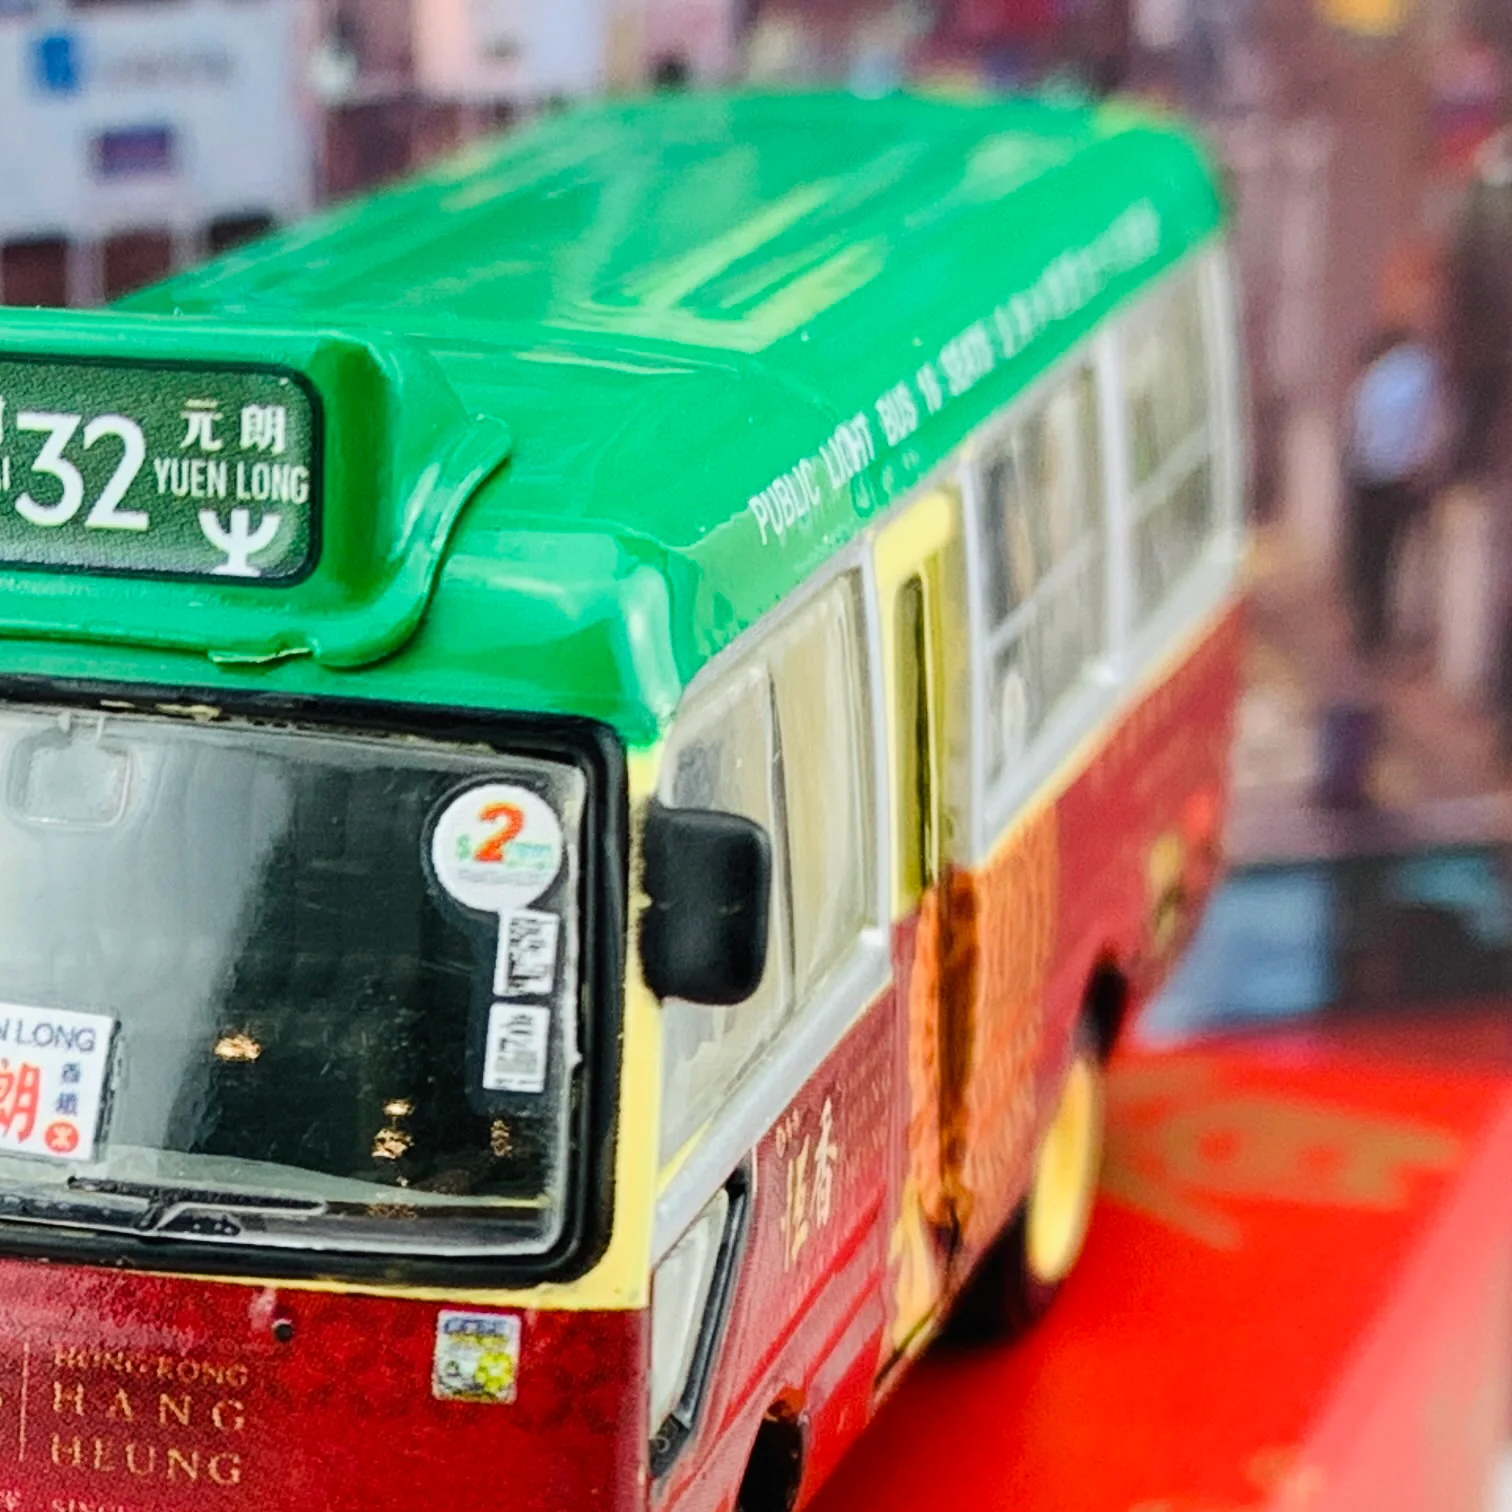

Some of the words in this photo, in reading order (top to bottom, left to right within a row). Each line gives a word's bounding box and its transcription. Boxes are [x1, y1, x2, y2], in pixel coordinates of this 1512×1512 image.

[179, 398, 286, 455] 元朗
[15, 411, 150, 531] 32
[153, 456, 228, 499] YUEN
[236, 460, 311, 505] LONG
[749, 457, 821, 545] PUBLIC
[16, 1019, 97, 1053] LONG
[52, 1381, 246, 1431] HANG
[51, 1432, 241, 1486] HEUNG
